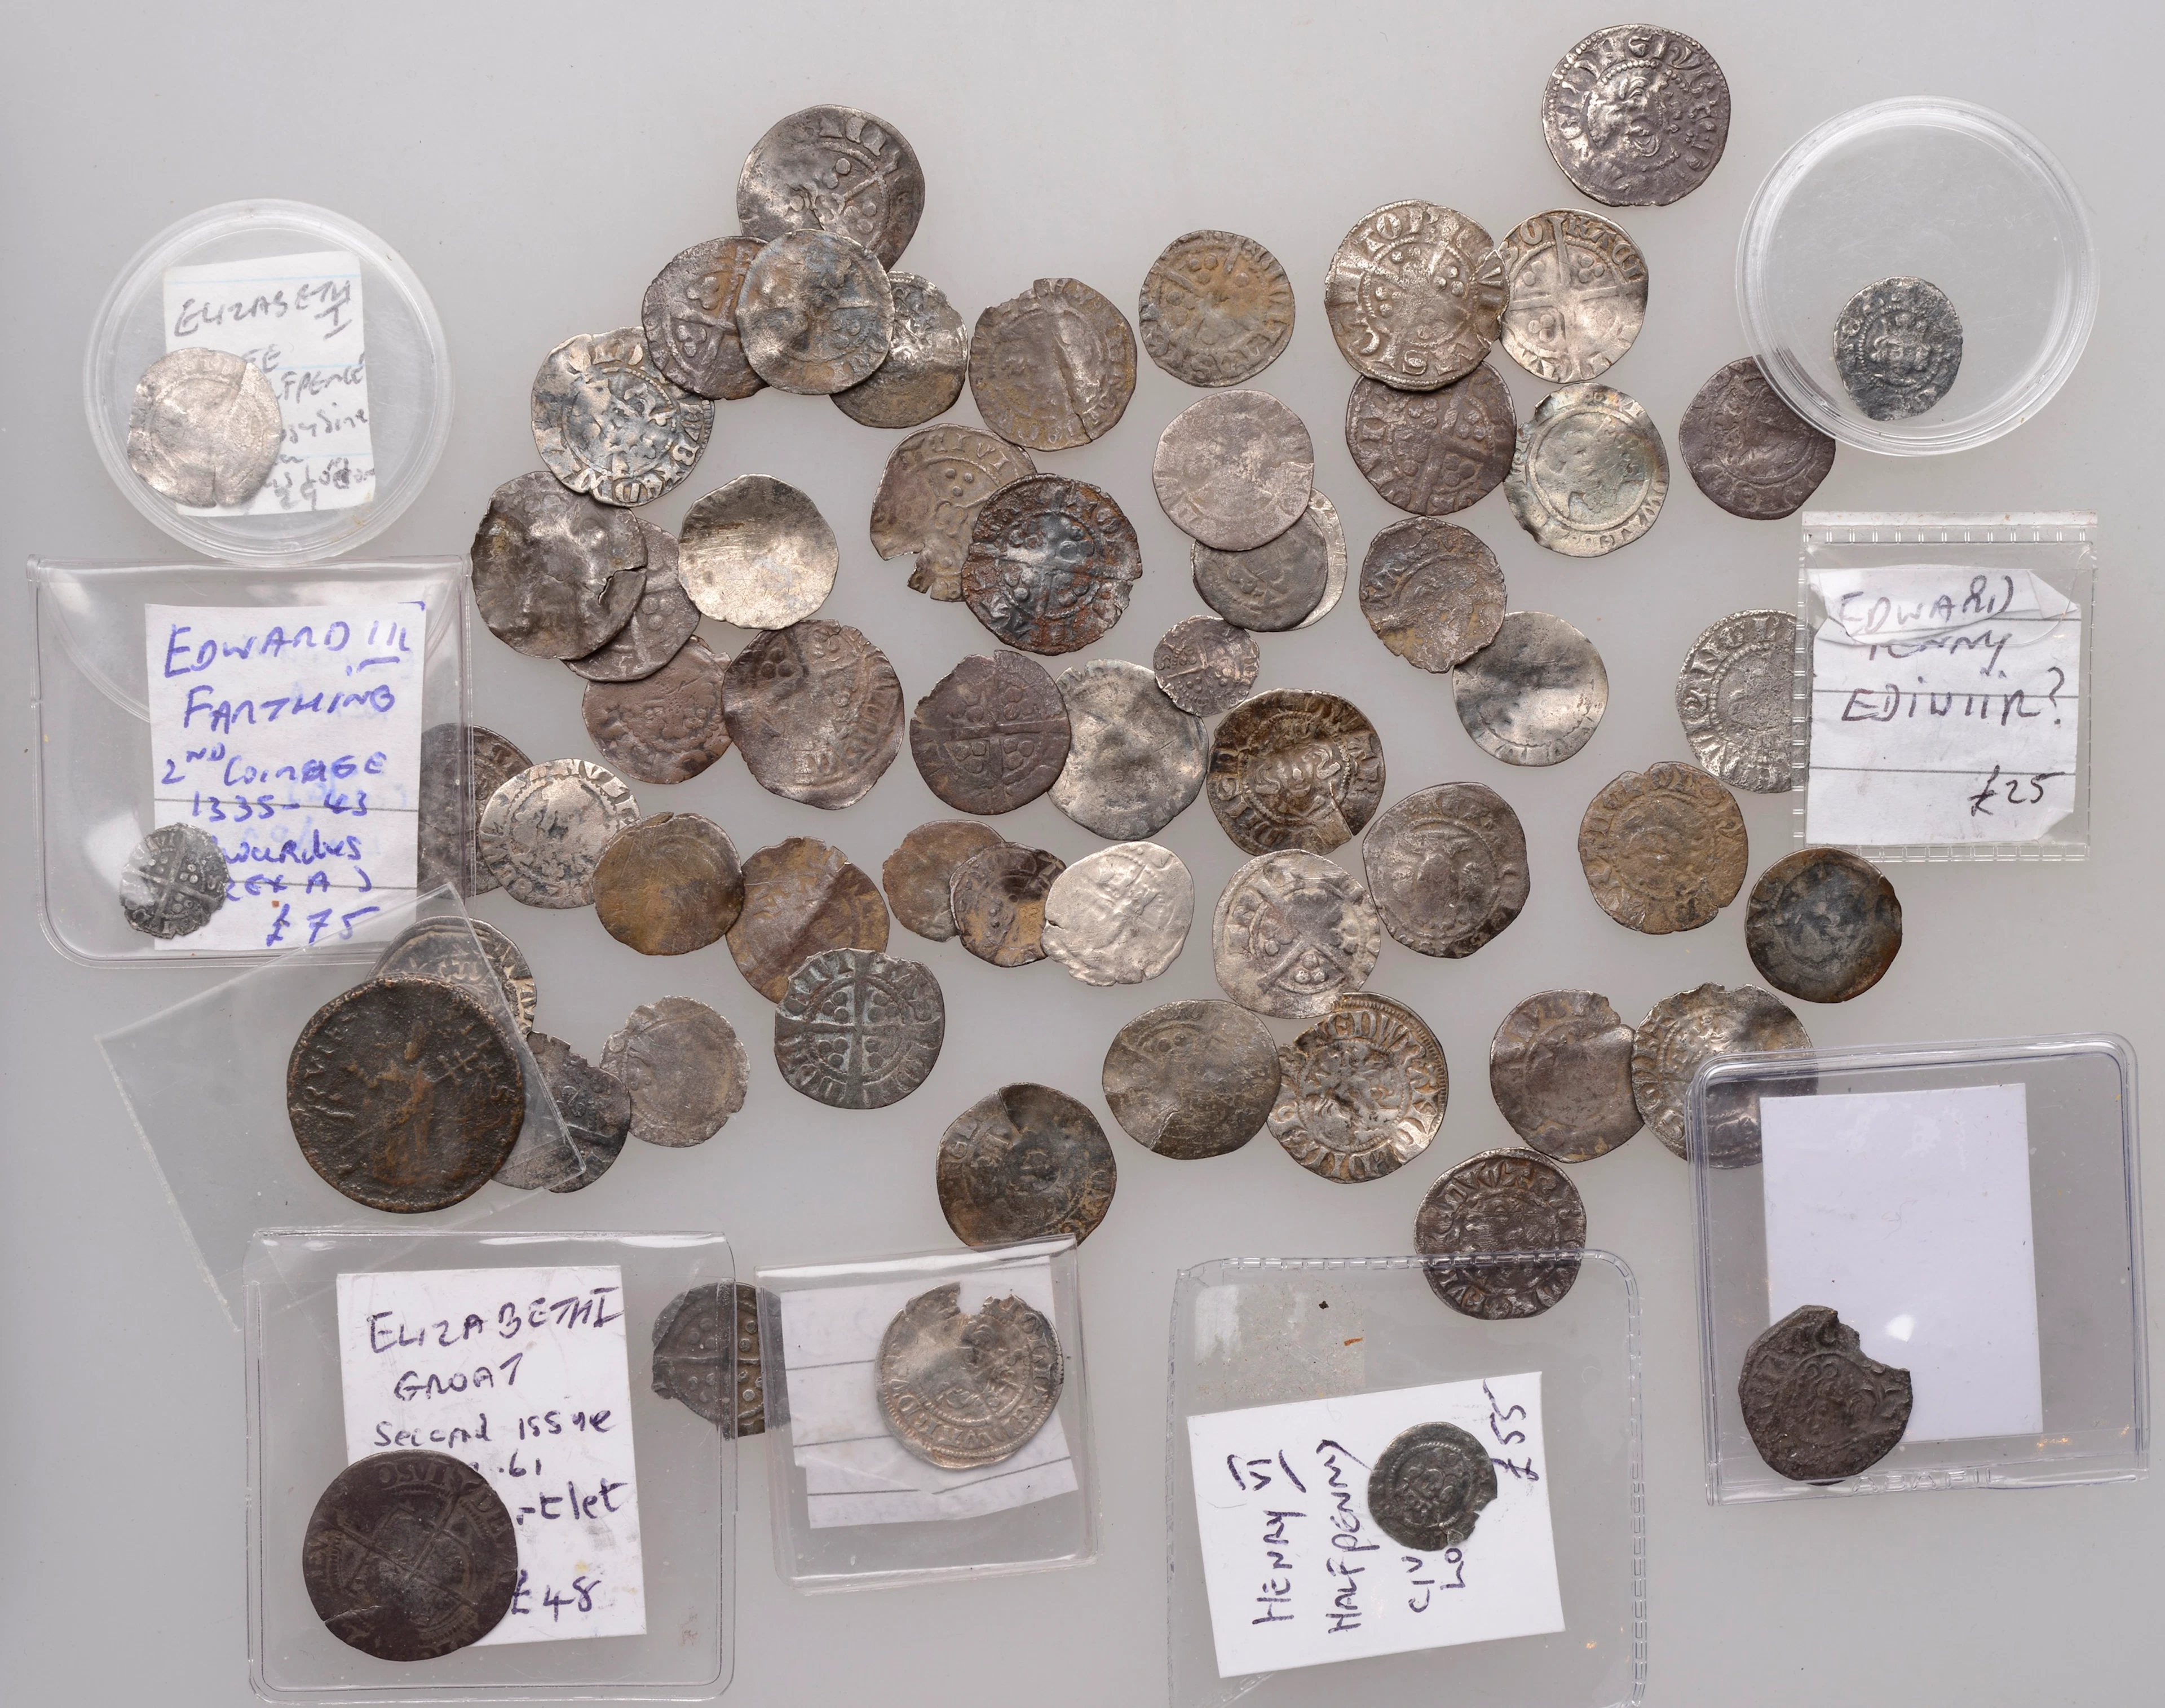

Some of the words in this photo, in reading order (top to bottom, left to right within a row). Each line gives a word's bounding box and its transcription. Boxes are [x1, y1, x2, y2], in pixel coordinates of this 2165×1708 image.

[174, 280, 351, 337] ELIZABETH
[276, 352, 366, 404] FPENCE
[1839, 575, 2014, 635] EDWARD
[165, 621, 351, 678] EDWARD
[1968, 764, 2066, 817] £25
[266, 903, 381, 947] £75
[366, 1297, 594, 1353] ELIZABETH
[394, 1352, 523, 1402] GROAT
[1483, 1379, 1540, 1482] £55
[511, 1569, 602, 1622] £48
[1252, 1509, 1307, 1626] HENRY
